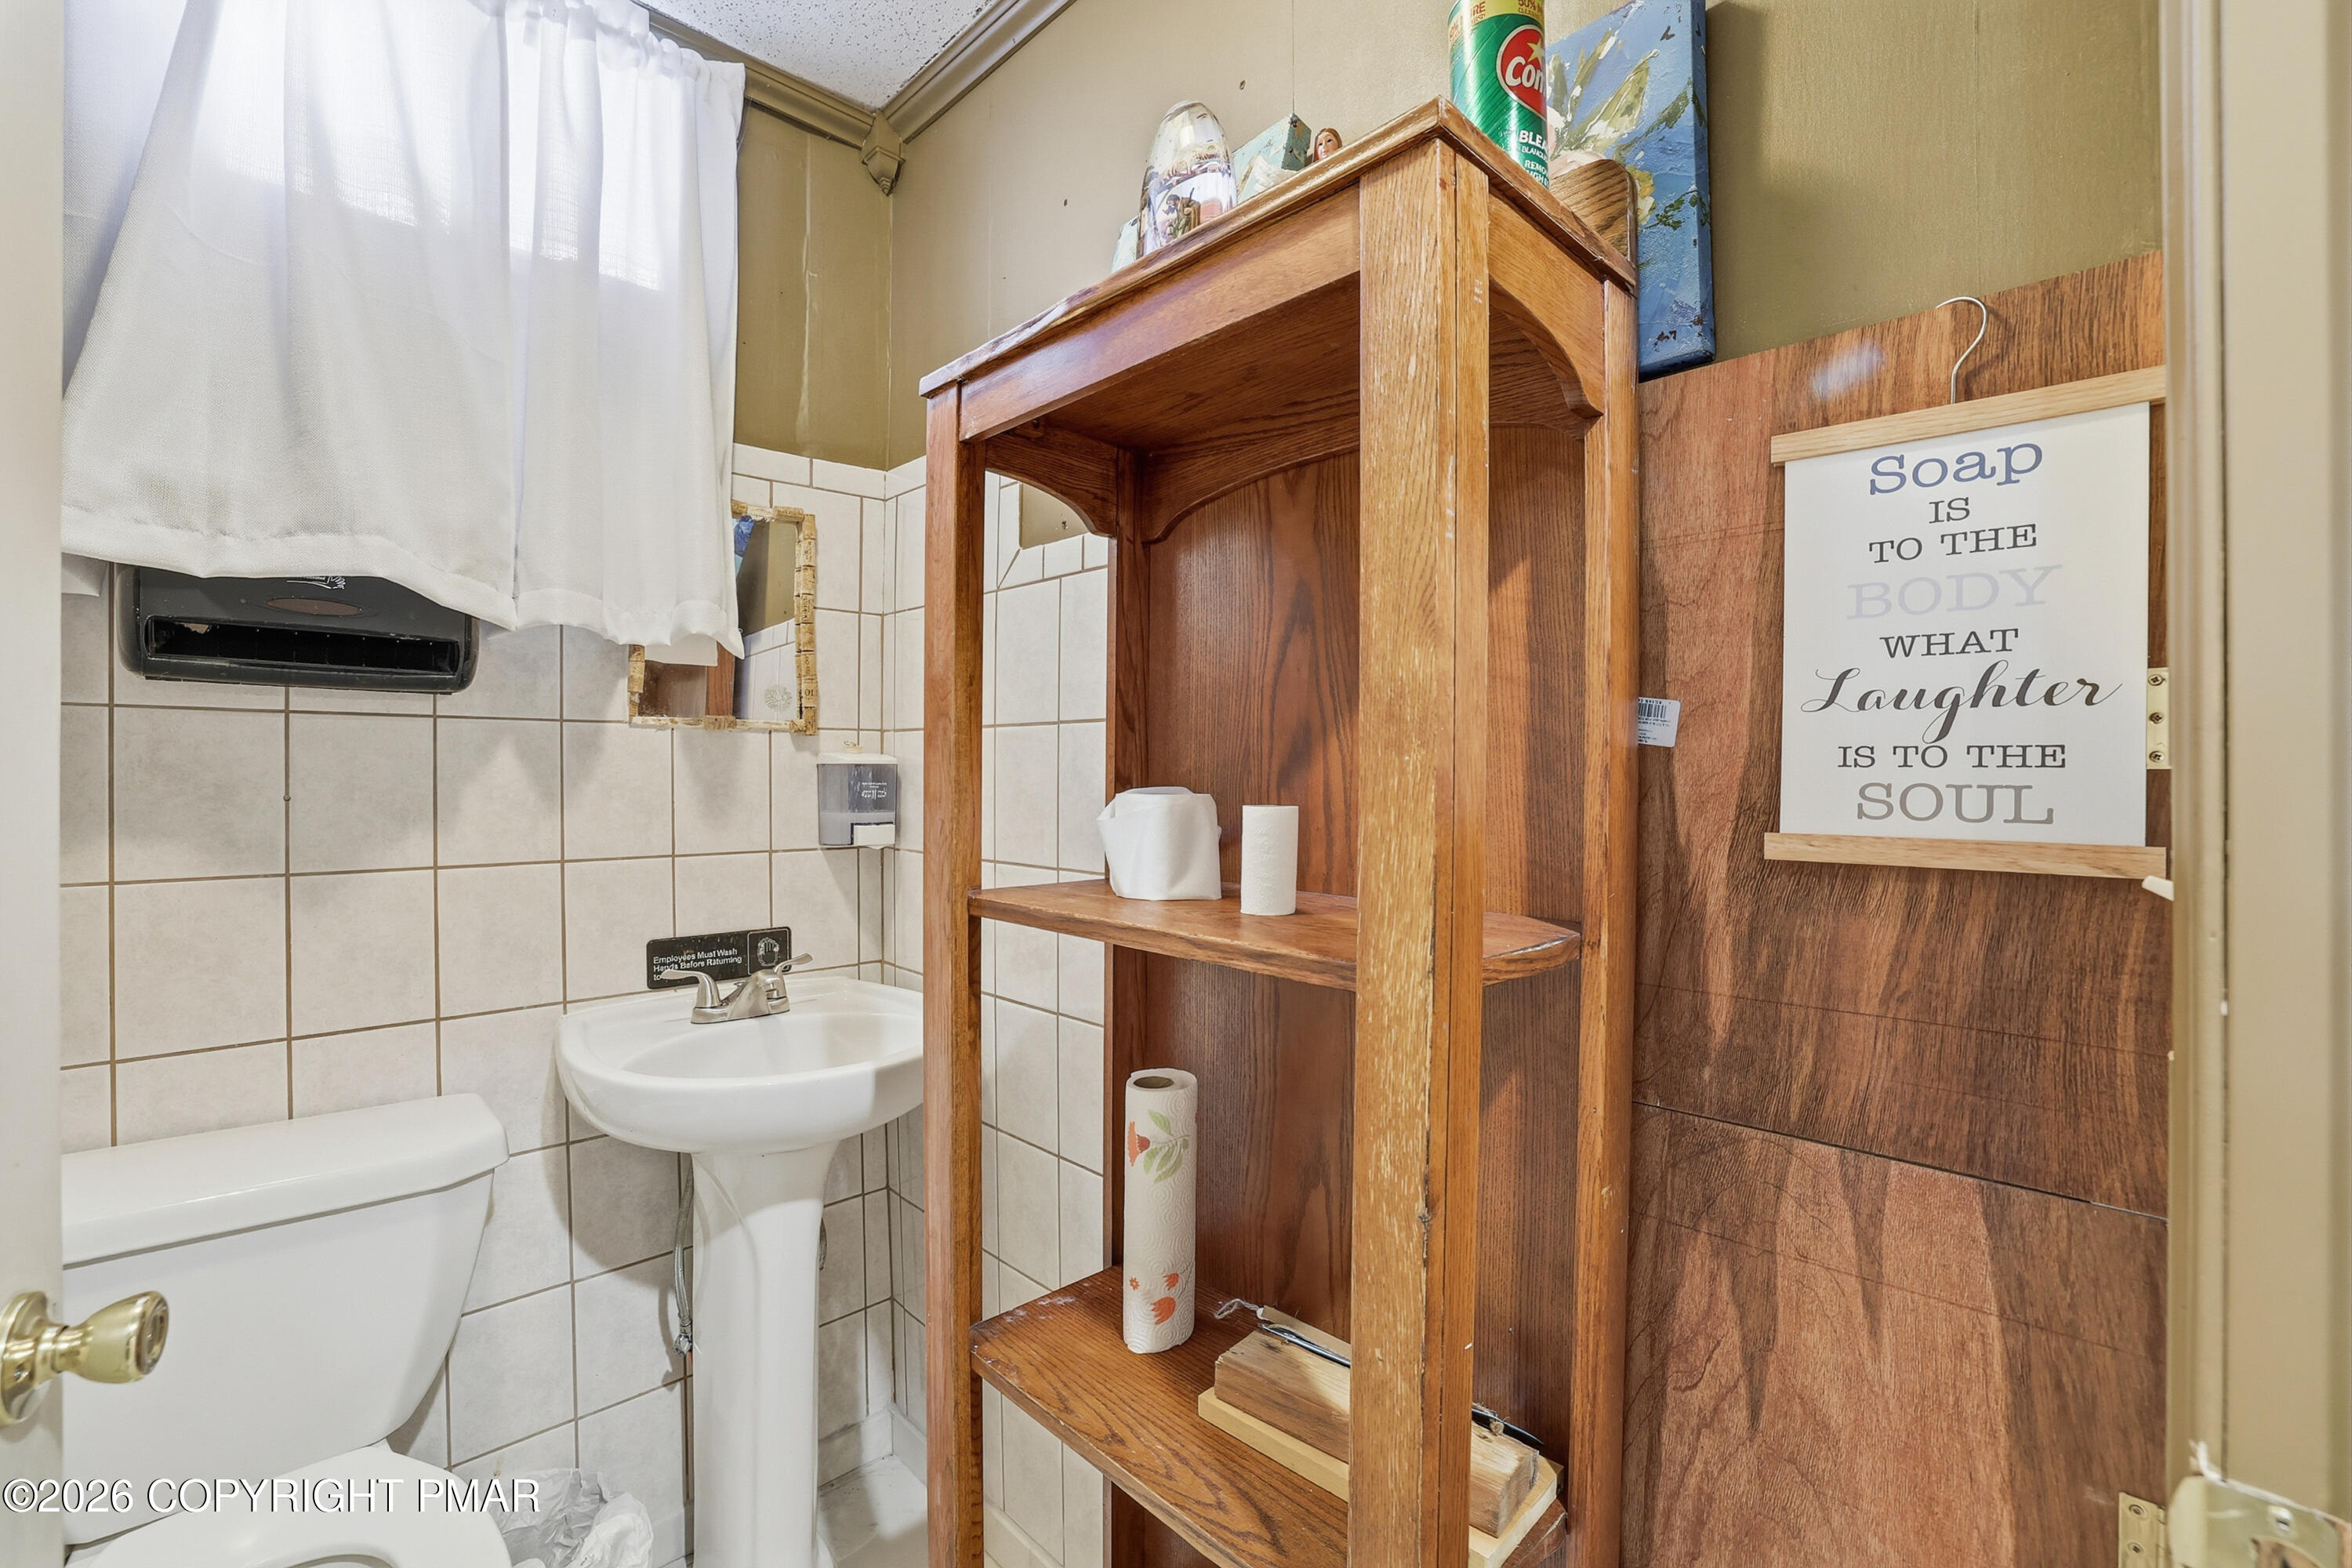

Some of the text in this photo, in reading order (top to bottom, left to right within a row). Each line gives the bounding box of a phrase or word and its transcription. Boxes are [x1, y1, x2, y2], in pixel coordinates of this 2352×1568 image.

[1870, 441, 2042, 495] Soap
[1929, 497, 1970, 524] IS
[1869, 524, 2037, 563] TO THE
[1847, 564, 2063, 619] BODY
[1880, 628, 2019, 659] WHAT
[1800, 659, 2123, 744] Laughter
[1838, 745, 2066, 768] IS TO THE
[1857, 782, 2053, 825] SOUL
[653, 948, 738, 964] Employees Must Wash
[681, 960, 705, 969] Before
[706, 956, 742, 966] Returning
